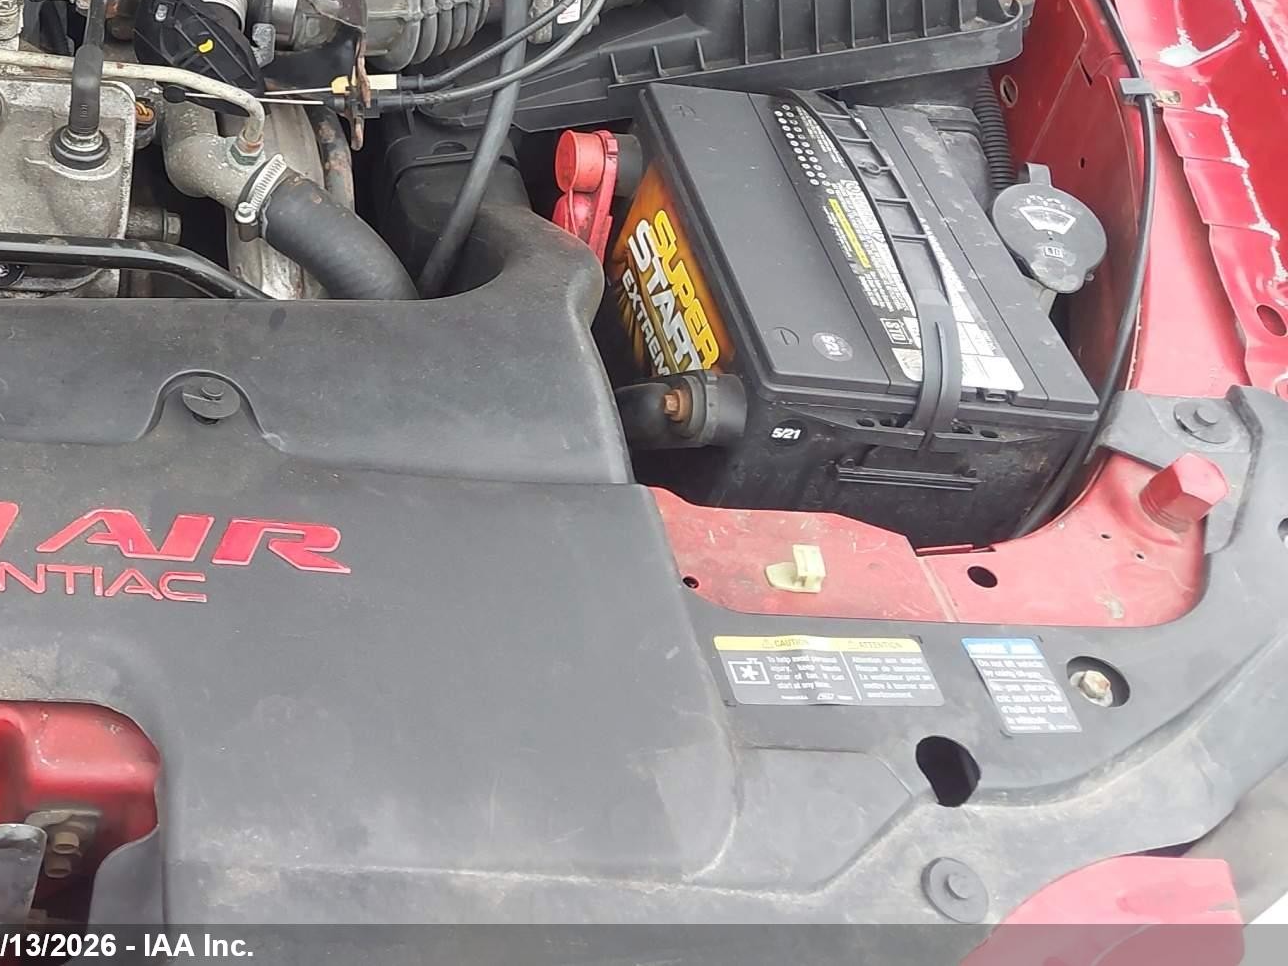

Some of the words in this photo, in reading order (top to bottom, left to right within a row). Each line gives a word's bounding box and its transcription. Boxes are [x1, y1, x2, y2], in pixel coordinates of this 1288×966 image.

[628, 219, 703, 372] START
[649, 209, 720, 370] SUPER
[771, 427, 801, 440] 5/21
[36, 508, 351, 574] AIR
